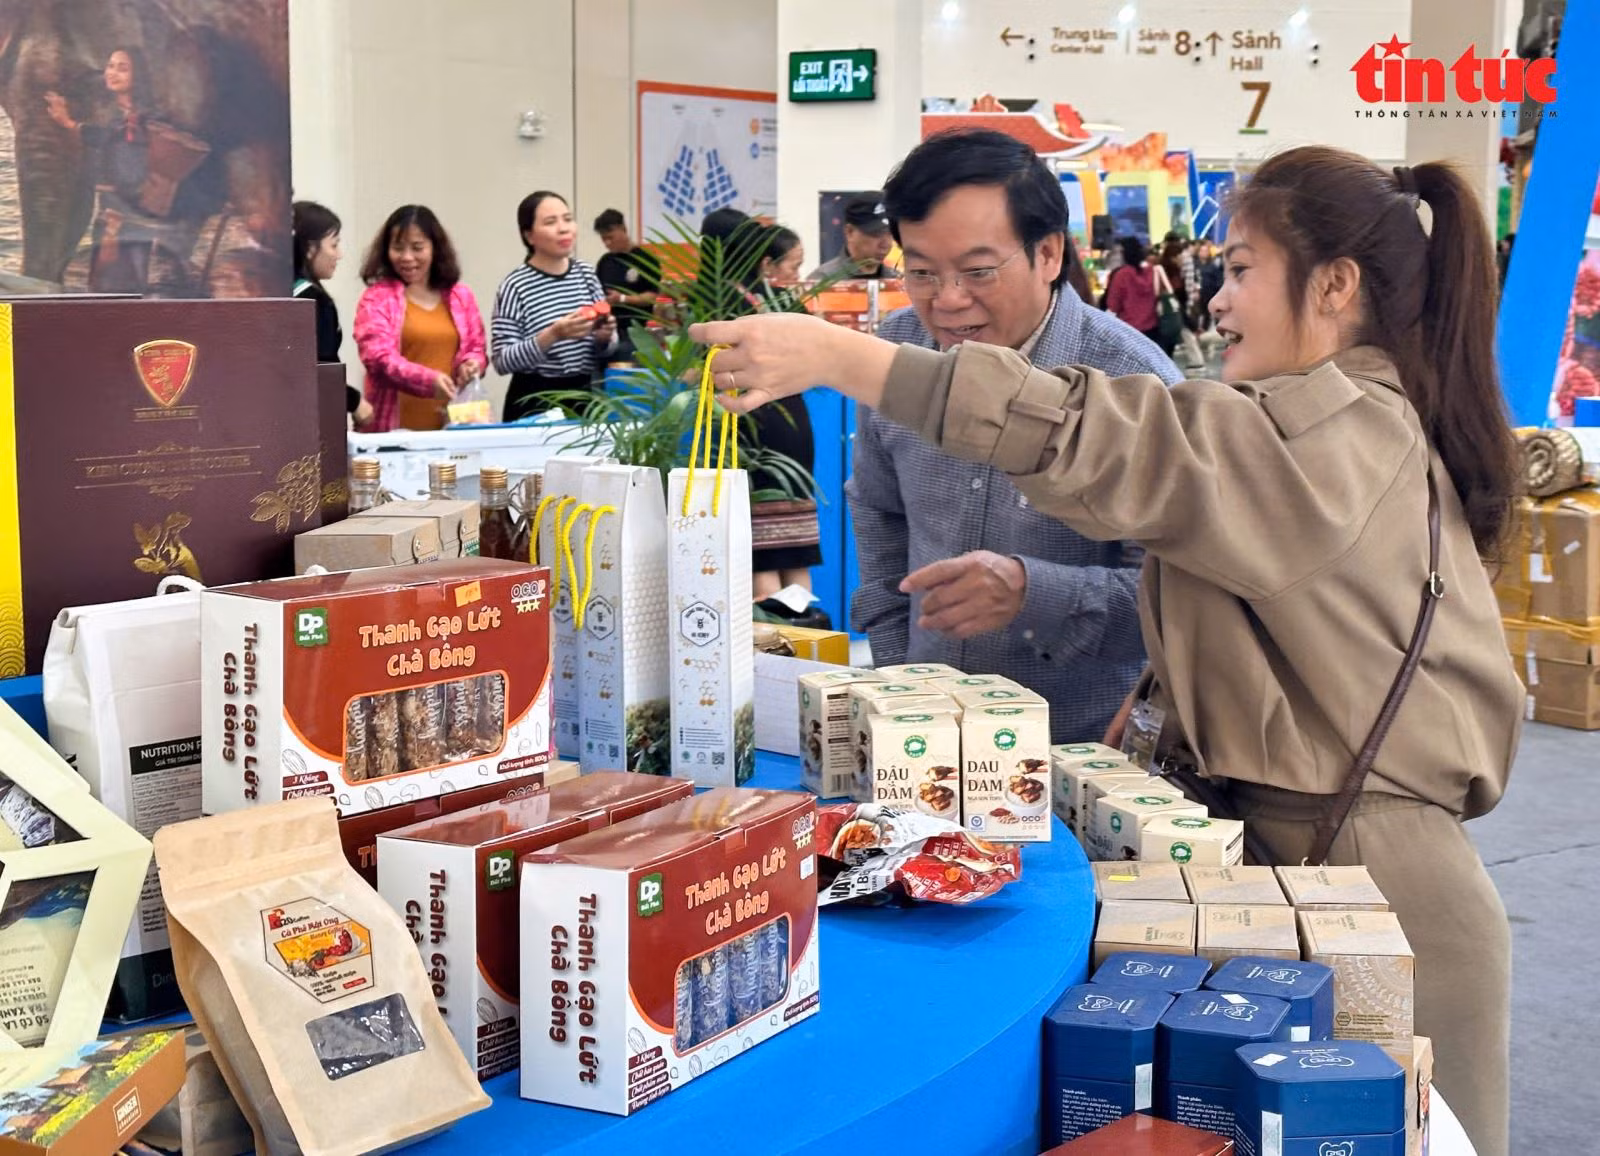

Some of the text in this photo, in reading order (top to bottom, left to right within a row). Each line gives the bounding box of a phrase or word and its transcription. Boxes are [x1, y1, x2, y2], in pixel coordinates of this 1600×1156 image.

[1052, 27, 1117, 43] Trung tâm
[1175, 31, 1191, 57] 8
[1232, 29, 1282, 50] Sảnh
[1084, 44, 1103, 54] Hall
[800, 61, 824, 75] EXIT
[1231, 57, 1262, 71] Hall
[1241, 82, 1270, 128] 7
[511, 580, 546, 599] OCOP
[299, 613, 324, 634] DP
[359, 606, 502, 648] Thanh Gạo Lứt
[429, 643, 476, 671] Bông
[241, 622, 260, 801] Thanh Gạo Lứt
[221, 704, 239, 762] Bông
[141, 743, 195, 760] NUTRITION
[877, 764, 909, 784] ĐẬU
[967, 760, 999, 773] DAU
[968, 779, 1003, 792] DAM
[490, 857, 511, 878] DP
[685, 847, 787, 910] Thanh Gạo Lứt
[641, 880, 660, 902] DP
[429, 869, 447, 945] Thanh
[735, 890, 769, 922] Bông
[323, 915, 340, 928] Ong
[427, 953, 448, 999] Gạo
[574, 893, 599, 1084] Thanh Gạo Lứt
[548, 979, 572, 1044] Bông
[3, 1014, 49, 1031] SÔ CÔ LA
